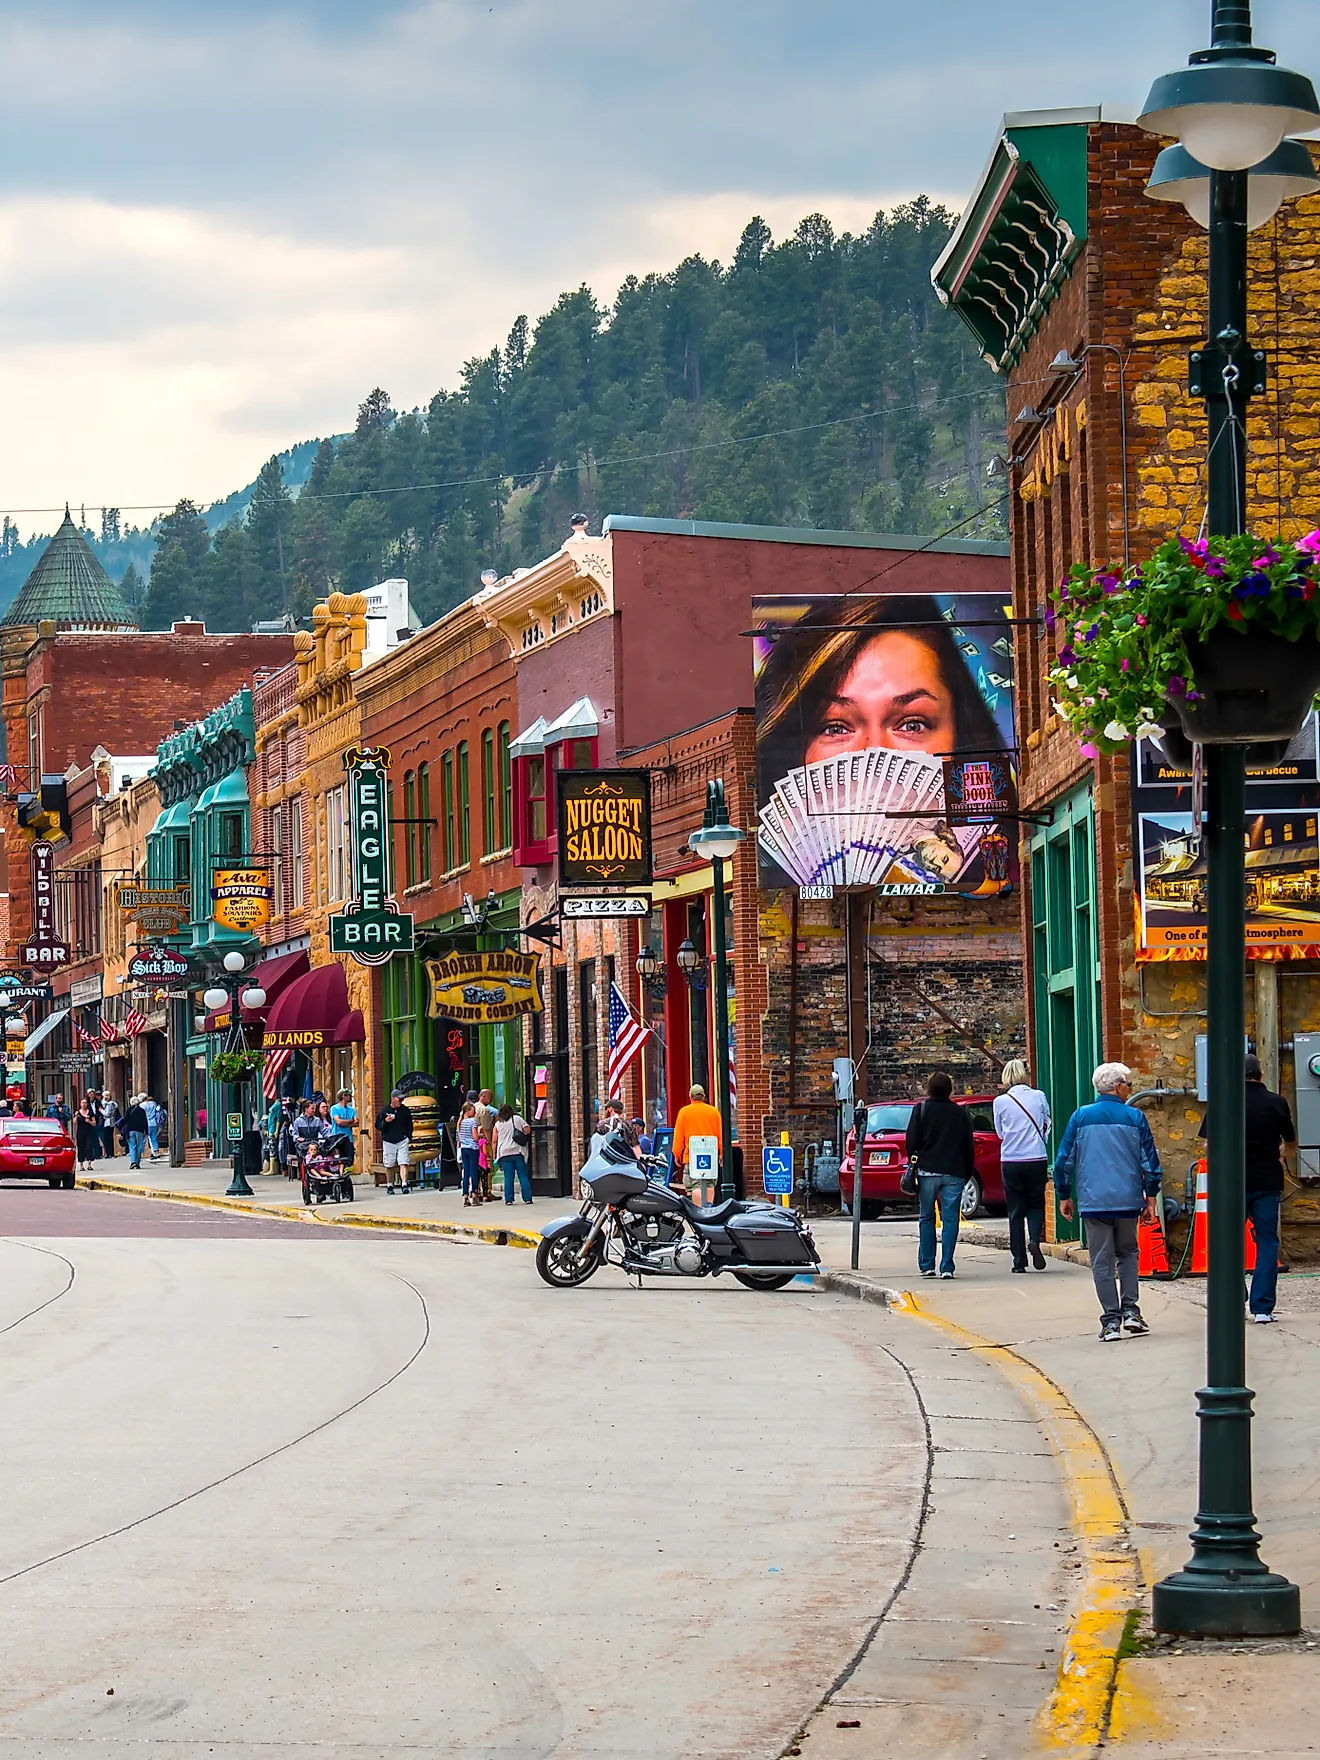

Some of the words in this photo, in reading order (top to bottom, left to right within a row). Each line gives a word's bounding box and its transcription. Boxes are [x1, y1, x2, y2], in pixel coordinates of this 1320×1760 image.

[962, 772, 993, 786] PINK
[963, 788, 996, 802] DOOR
[565, 798, 643, 836] NUGGET
[360, 783, 379, 911] EAGLE
[566, 824, 643, 862] SALOON
[37, 848, 50, 891] WILD
[222, 872, 261, 883] Ava
[217, 887, 268, 898] APPAREL
[801, 886, 832, 898] 80428
[881, 884, 937, 895] LAMAR
[566, 899, 646, 913] PIZZA
[38, 897, 51, 940] BILL
[344, 922, 402, 944] BAR
[1165, 930, 1186, 941] One
[1189, 930, 1202, 940] of
[1244, 927, 1304, 940] tmosphere
[26, 947, 66, 962] BAR
[131, 960, 161, 976] Sick
[162, 960, 188, 976] Boy
[430, 954, 483, 981] BROKEN
[486, 954, 535, 975] ARROW
[436, 1003, 482, 1019] TRADING
[486, 997, 536, 1018] COMPANY
[263, 1032, 277, 1046] BAD
[278, 1031, 324, 1046] LANDS
